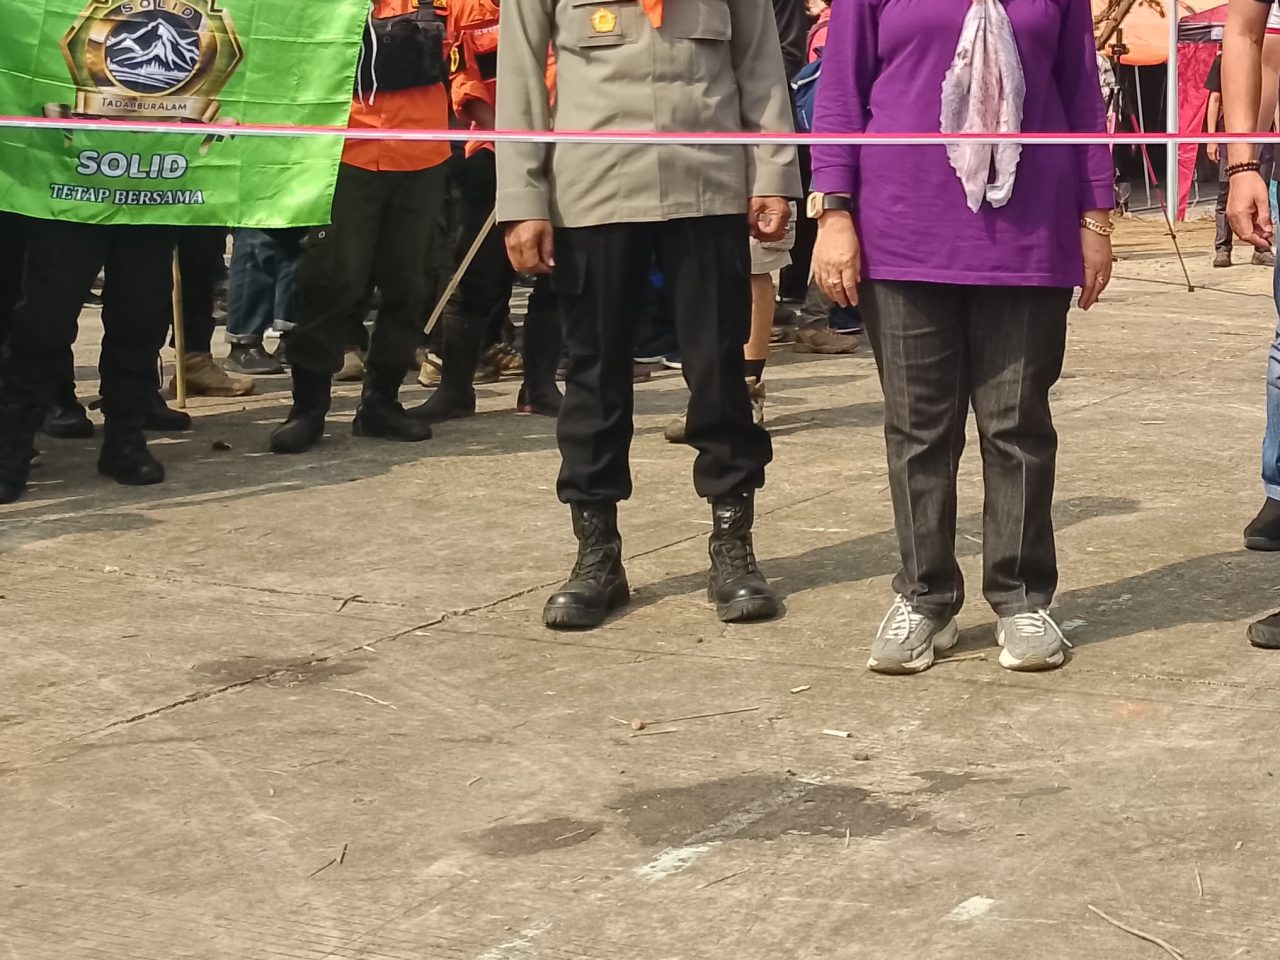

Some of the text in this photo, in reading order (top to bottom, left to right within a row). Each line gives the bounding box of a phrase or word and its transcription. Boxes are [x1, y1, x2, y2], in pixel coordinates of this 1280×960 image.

[76, 149, 188, 179] SOLID
[50, 183, 205, 206] TETAP BERSAMA
